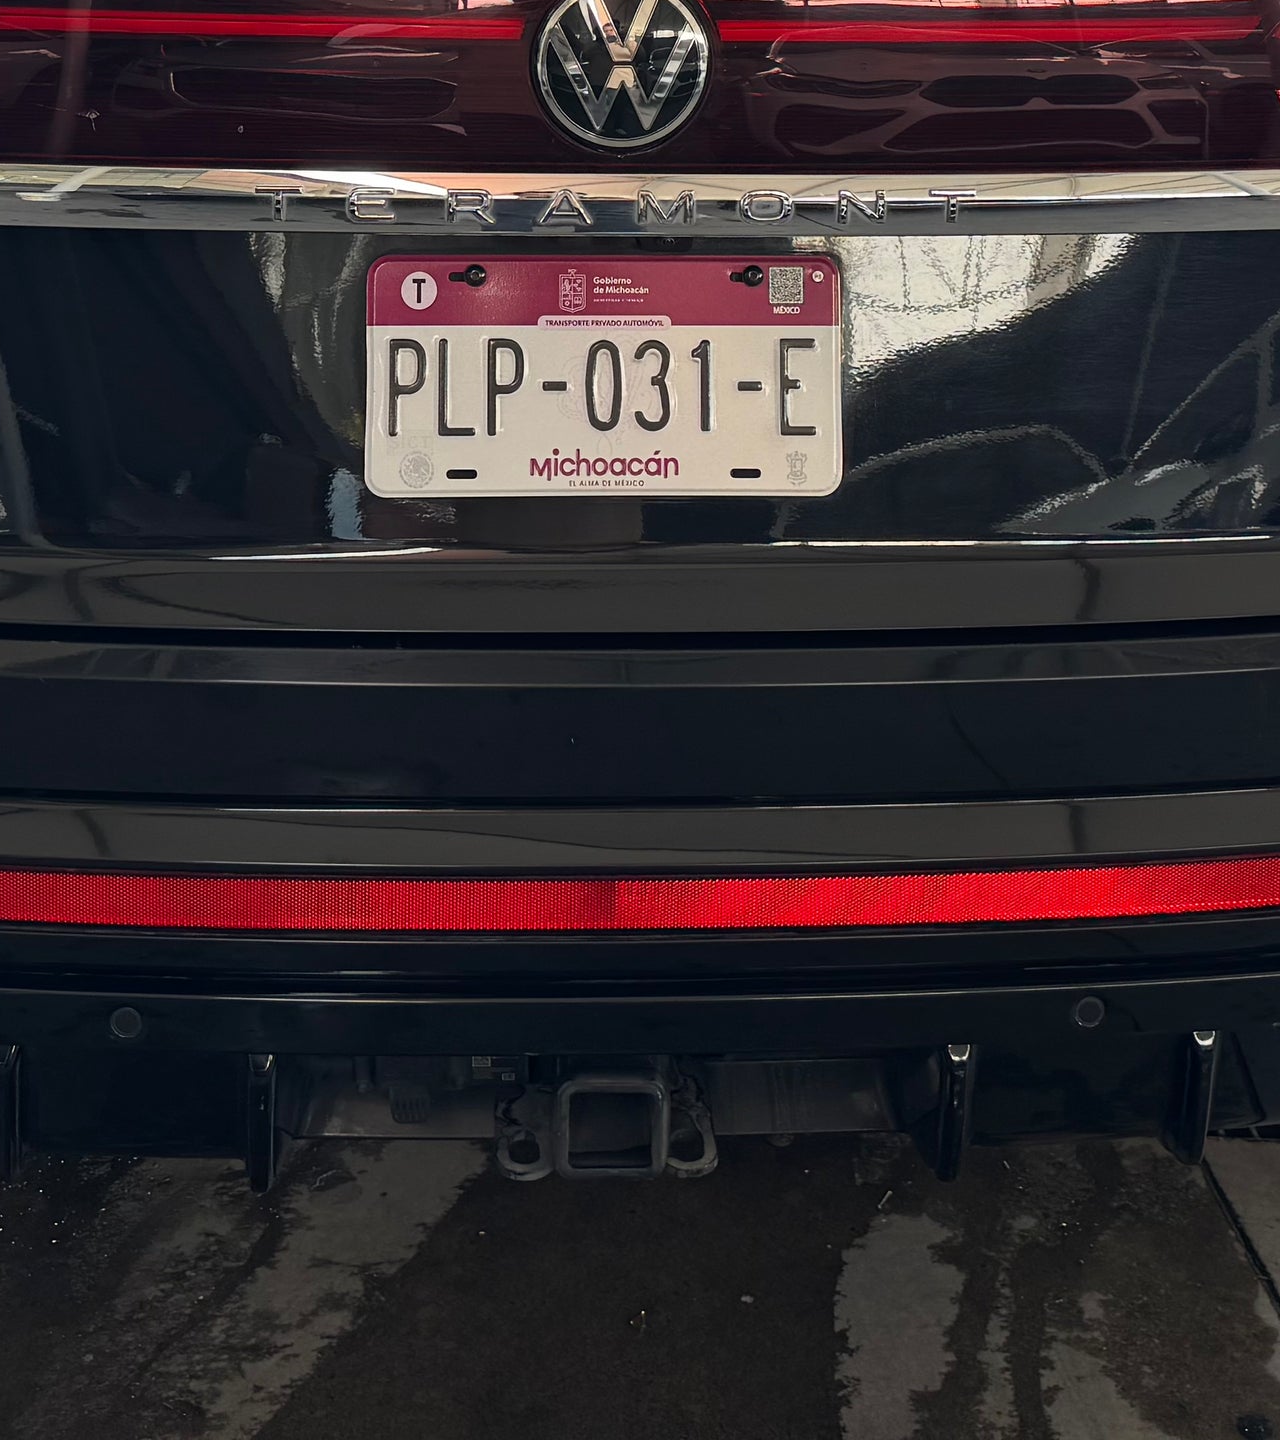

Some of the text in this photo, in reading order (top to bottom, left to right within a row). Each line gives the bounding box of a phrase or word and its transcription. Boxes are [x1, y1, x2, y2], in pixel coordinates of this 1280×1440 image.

[254, 185, 978, 224] TERAMONT
[593, 276, 632, 285] Gobierno
[412, 278, 426, 304] T
[593, 286, 649, 294] de Michoacán
[545, 317, 665, 327] TRANSPORTE PRIVADO AUTOMÓVIL
[388, 337, 817, 437] PLP-031-E
[529, 448, 680, 482] Michoacán
[569, 478, 645, 487] EL ALMA DE MÉXICO
